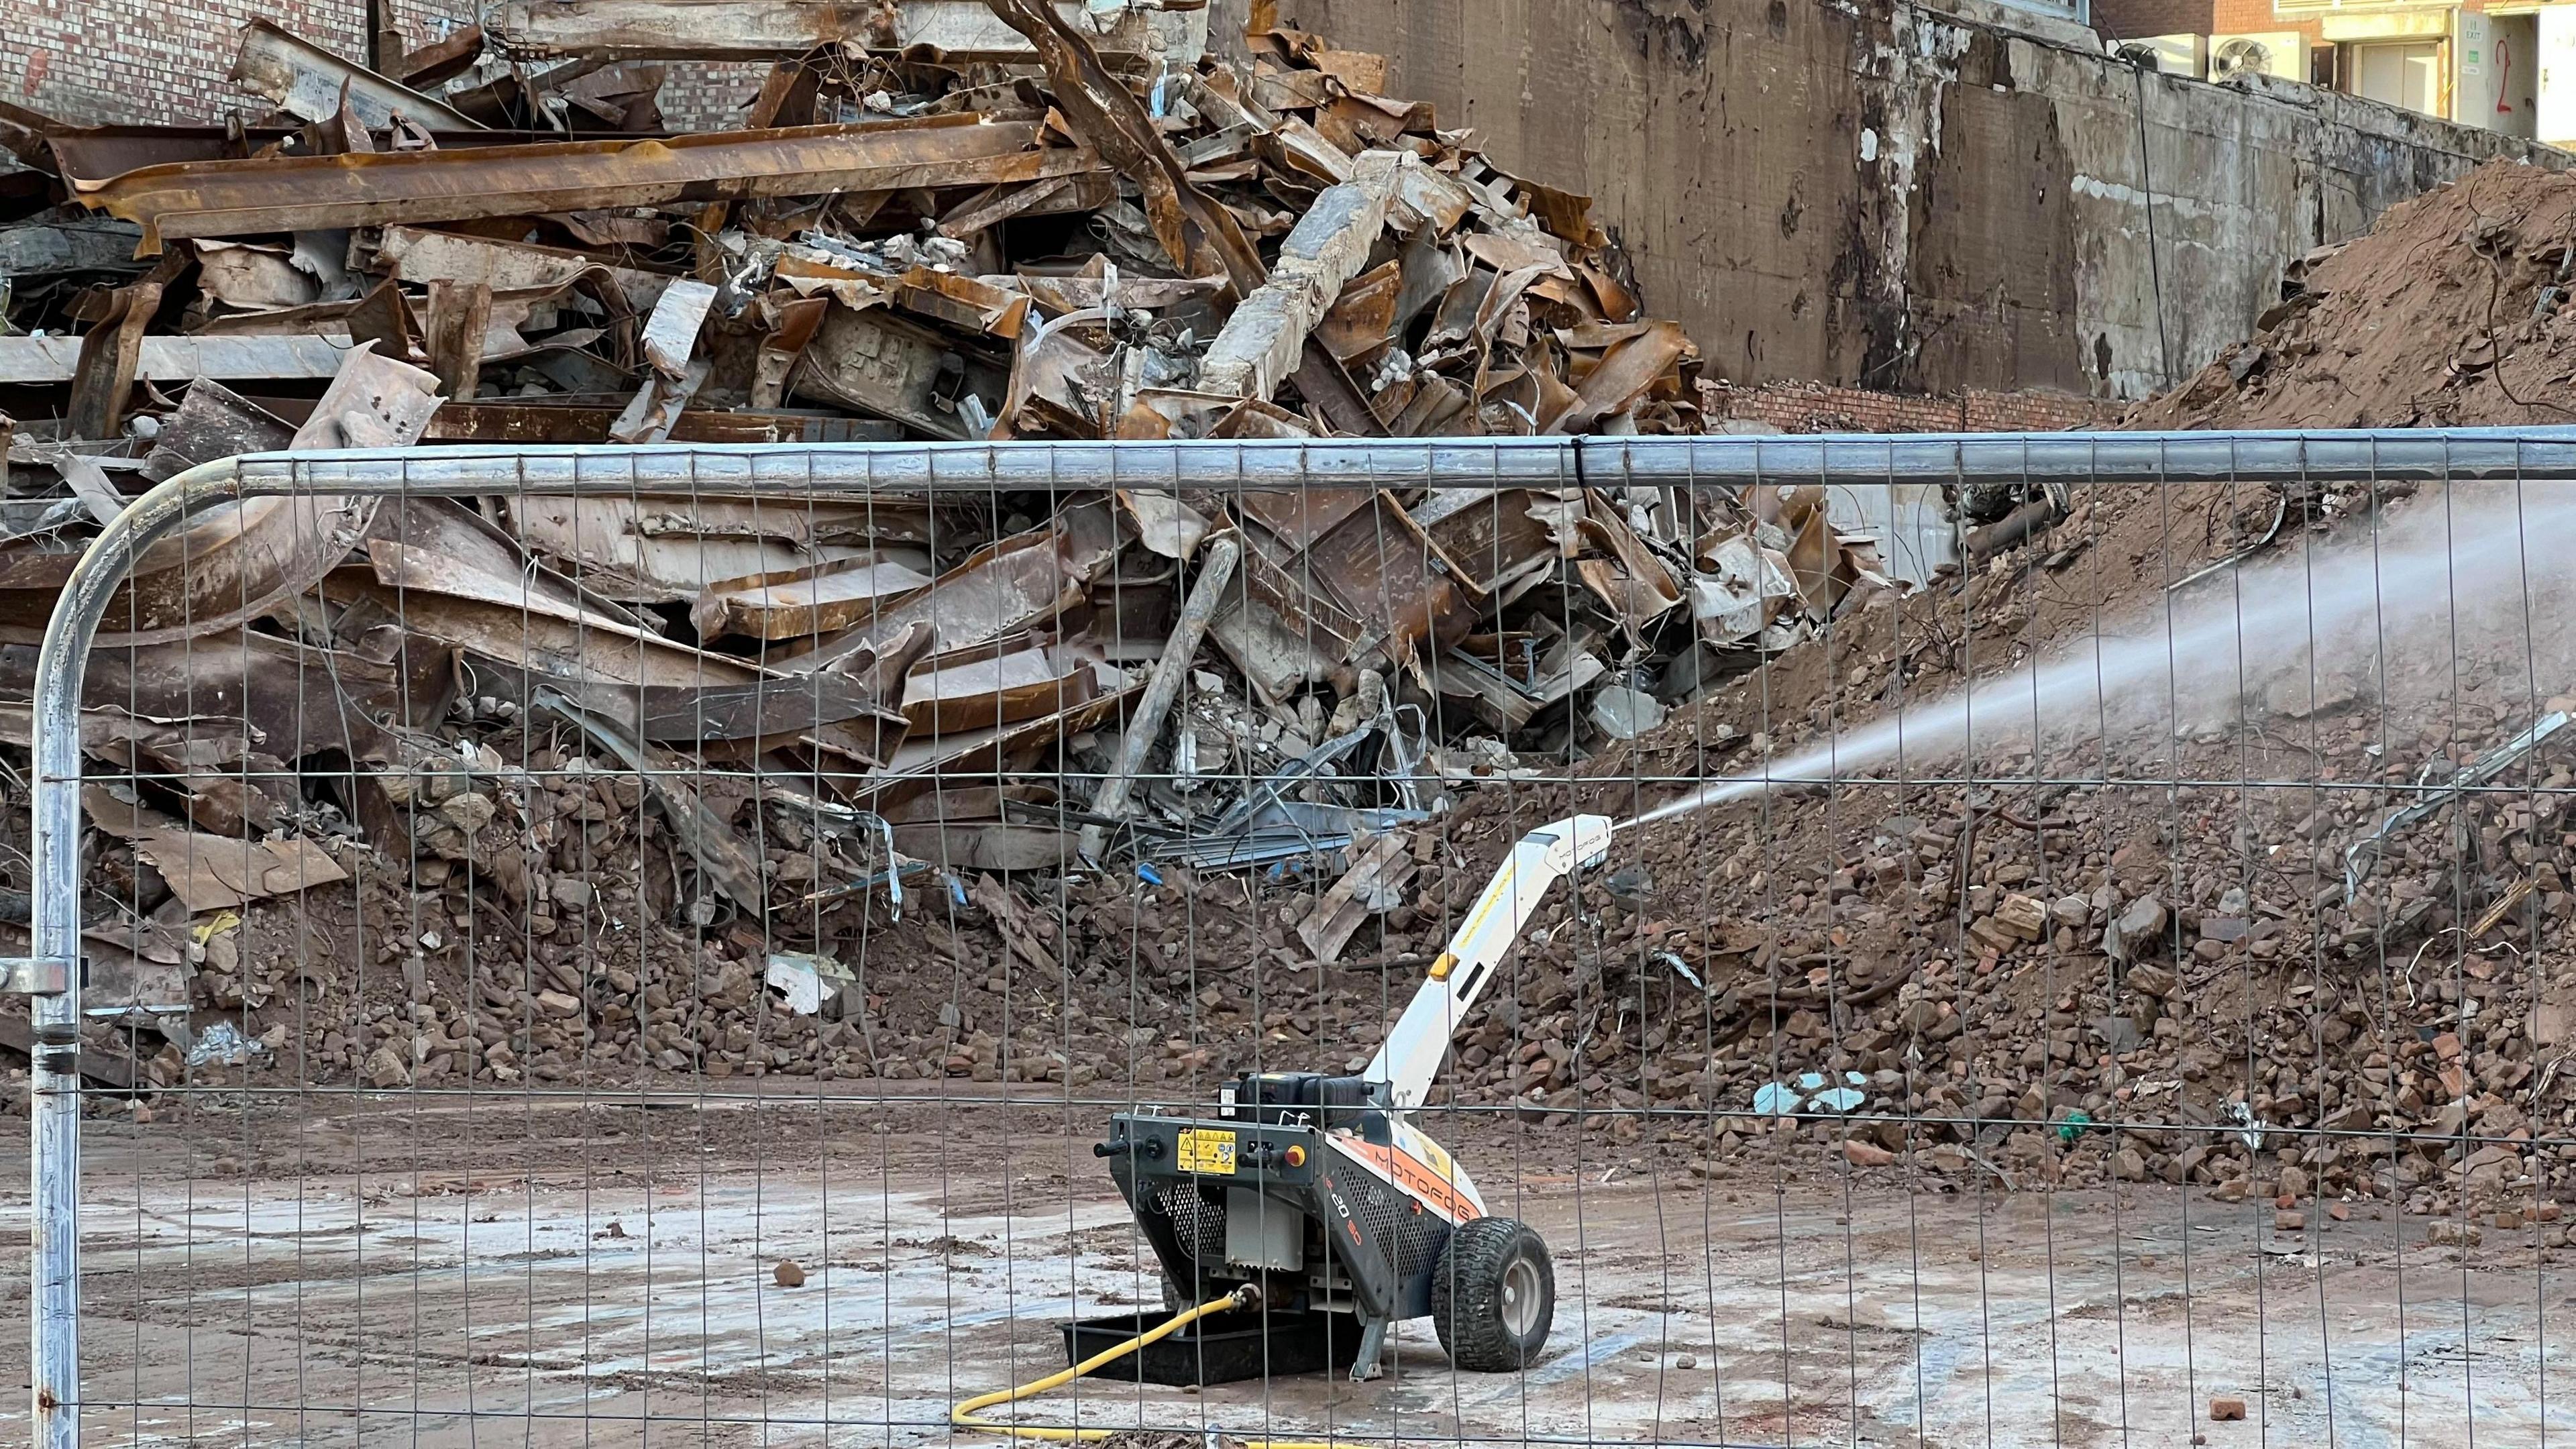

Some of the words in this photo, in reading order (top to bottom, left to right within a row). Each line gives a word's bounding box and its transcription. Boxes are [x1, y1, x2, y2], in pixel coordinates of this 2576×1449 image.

[2466, 31, 2481, 40] EXIT
[1375, 1150, 1470, 1221] MOTOFOG
[1331, 1193, 1350, 1218] 20
